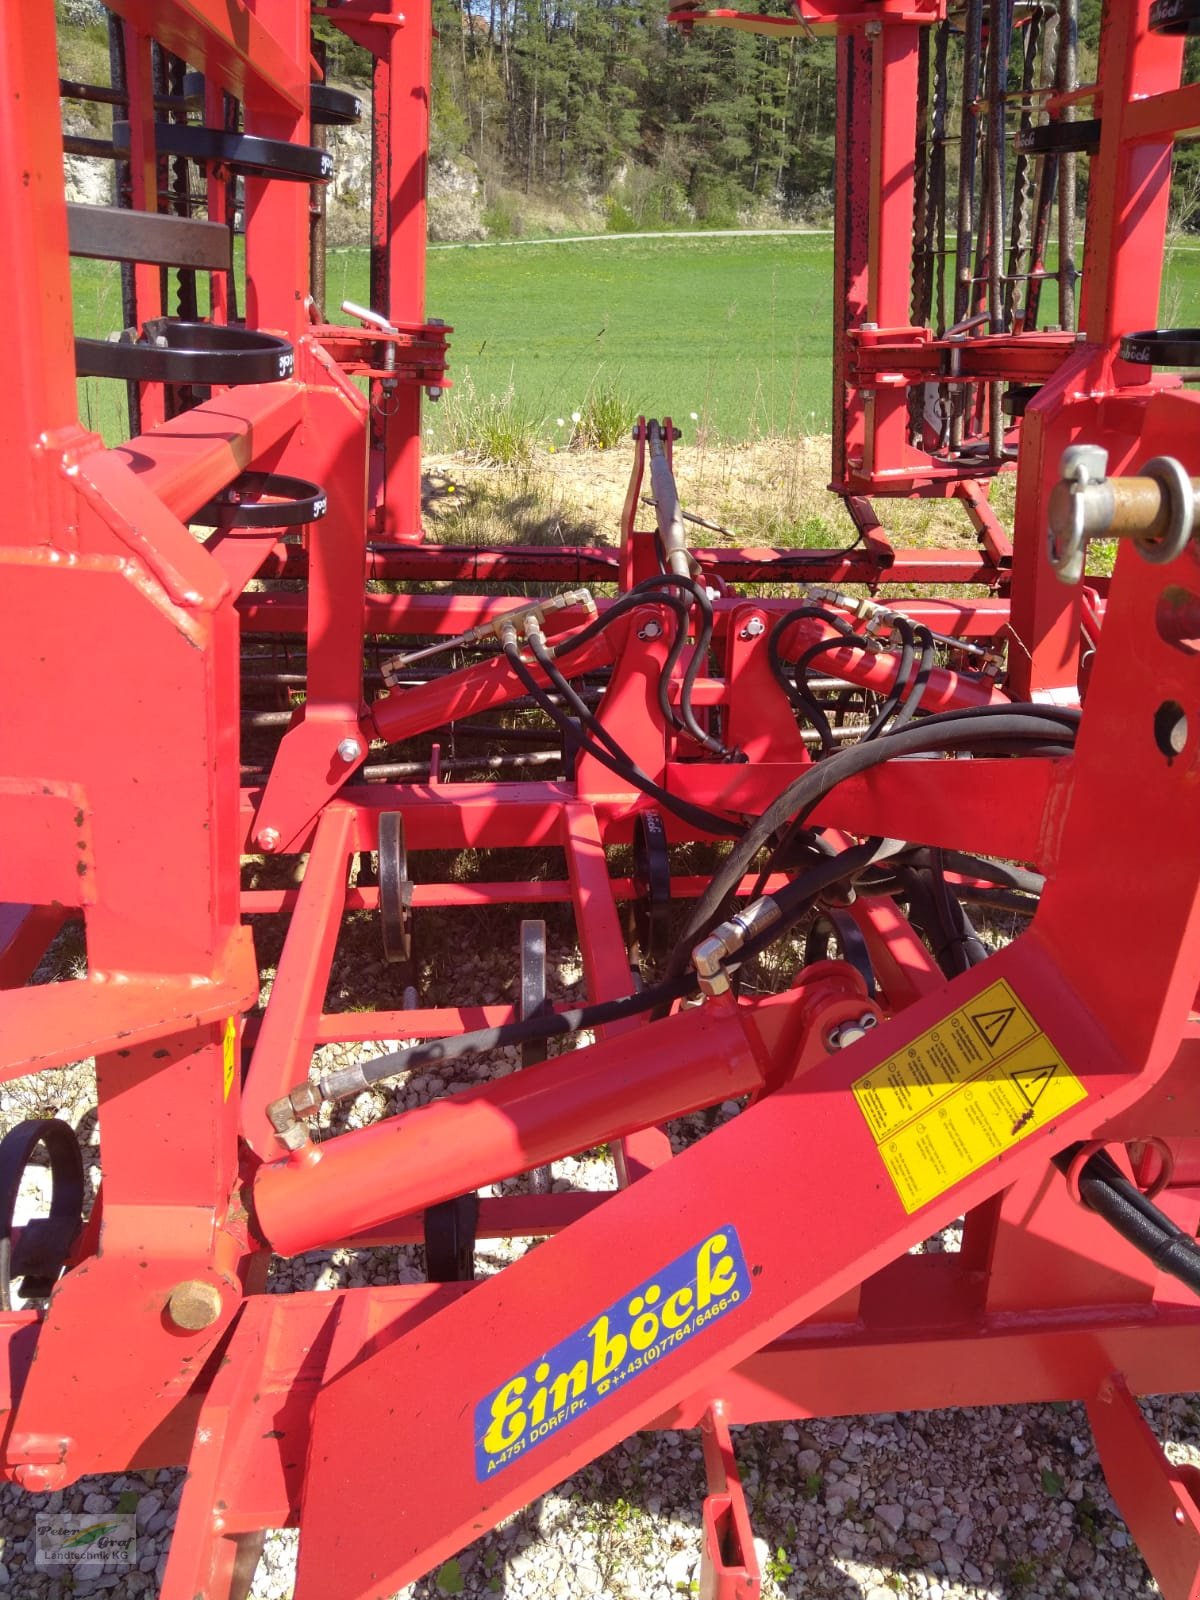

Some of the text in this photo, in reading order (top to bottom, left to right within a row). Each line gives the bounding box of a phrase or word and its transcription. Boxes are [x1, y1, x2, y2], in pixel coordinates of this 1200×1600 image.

[484, 1234, 737, 1454] Einböck
[487, 1438, 526, 1473] A-4751
[530, 1398, 587, 1443] DORF/Pr.
